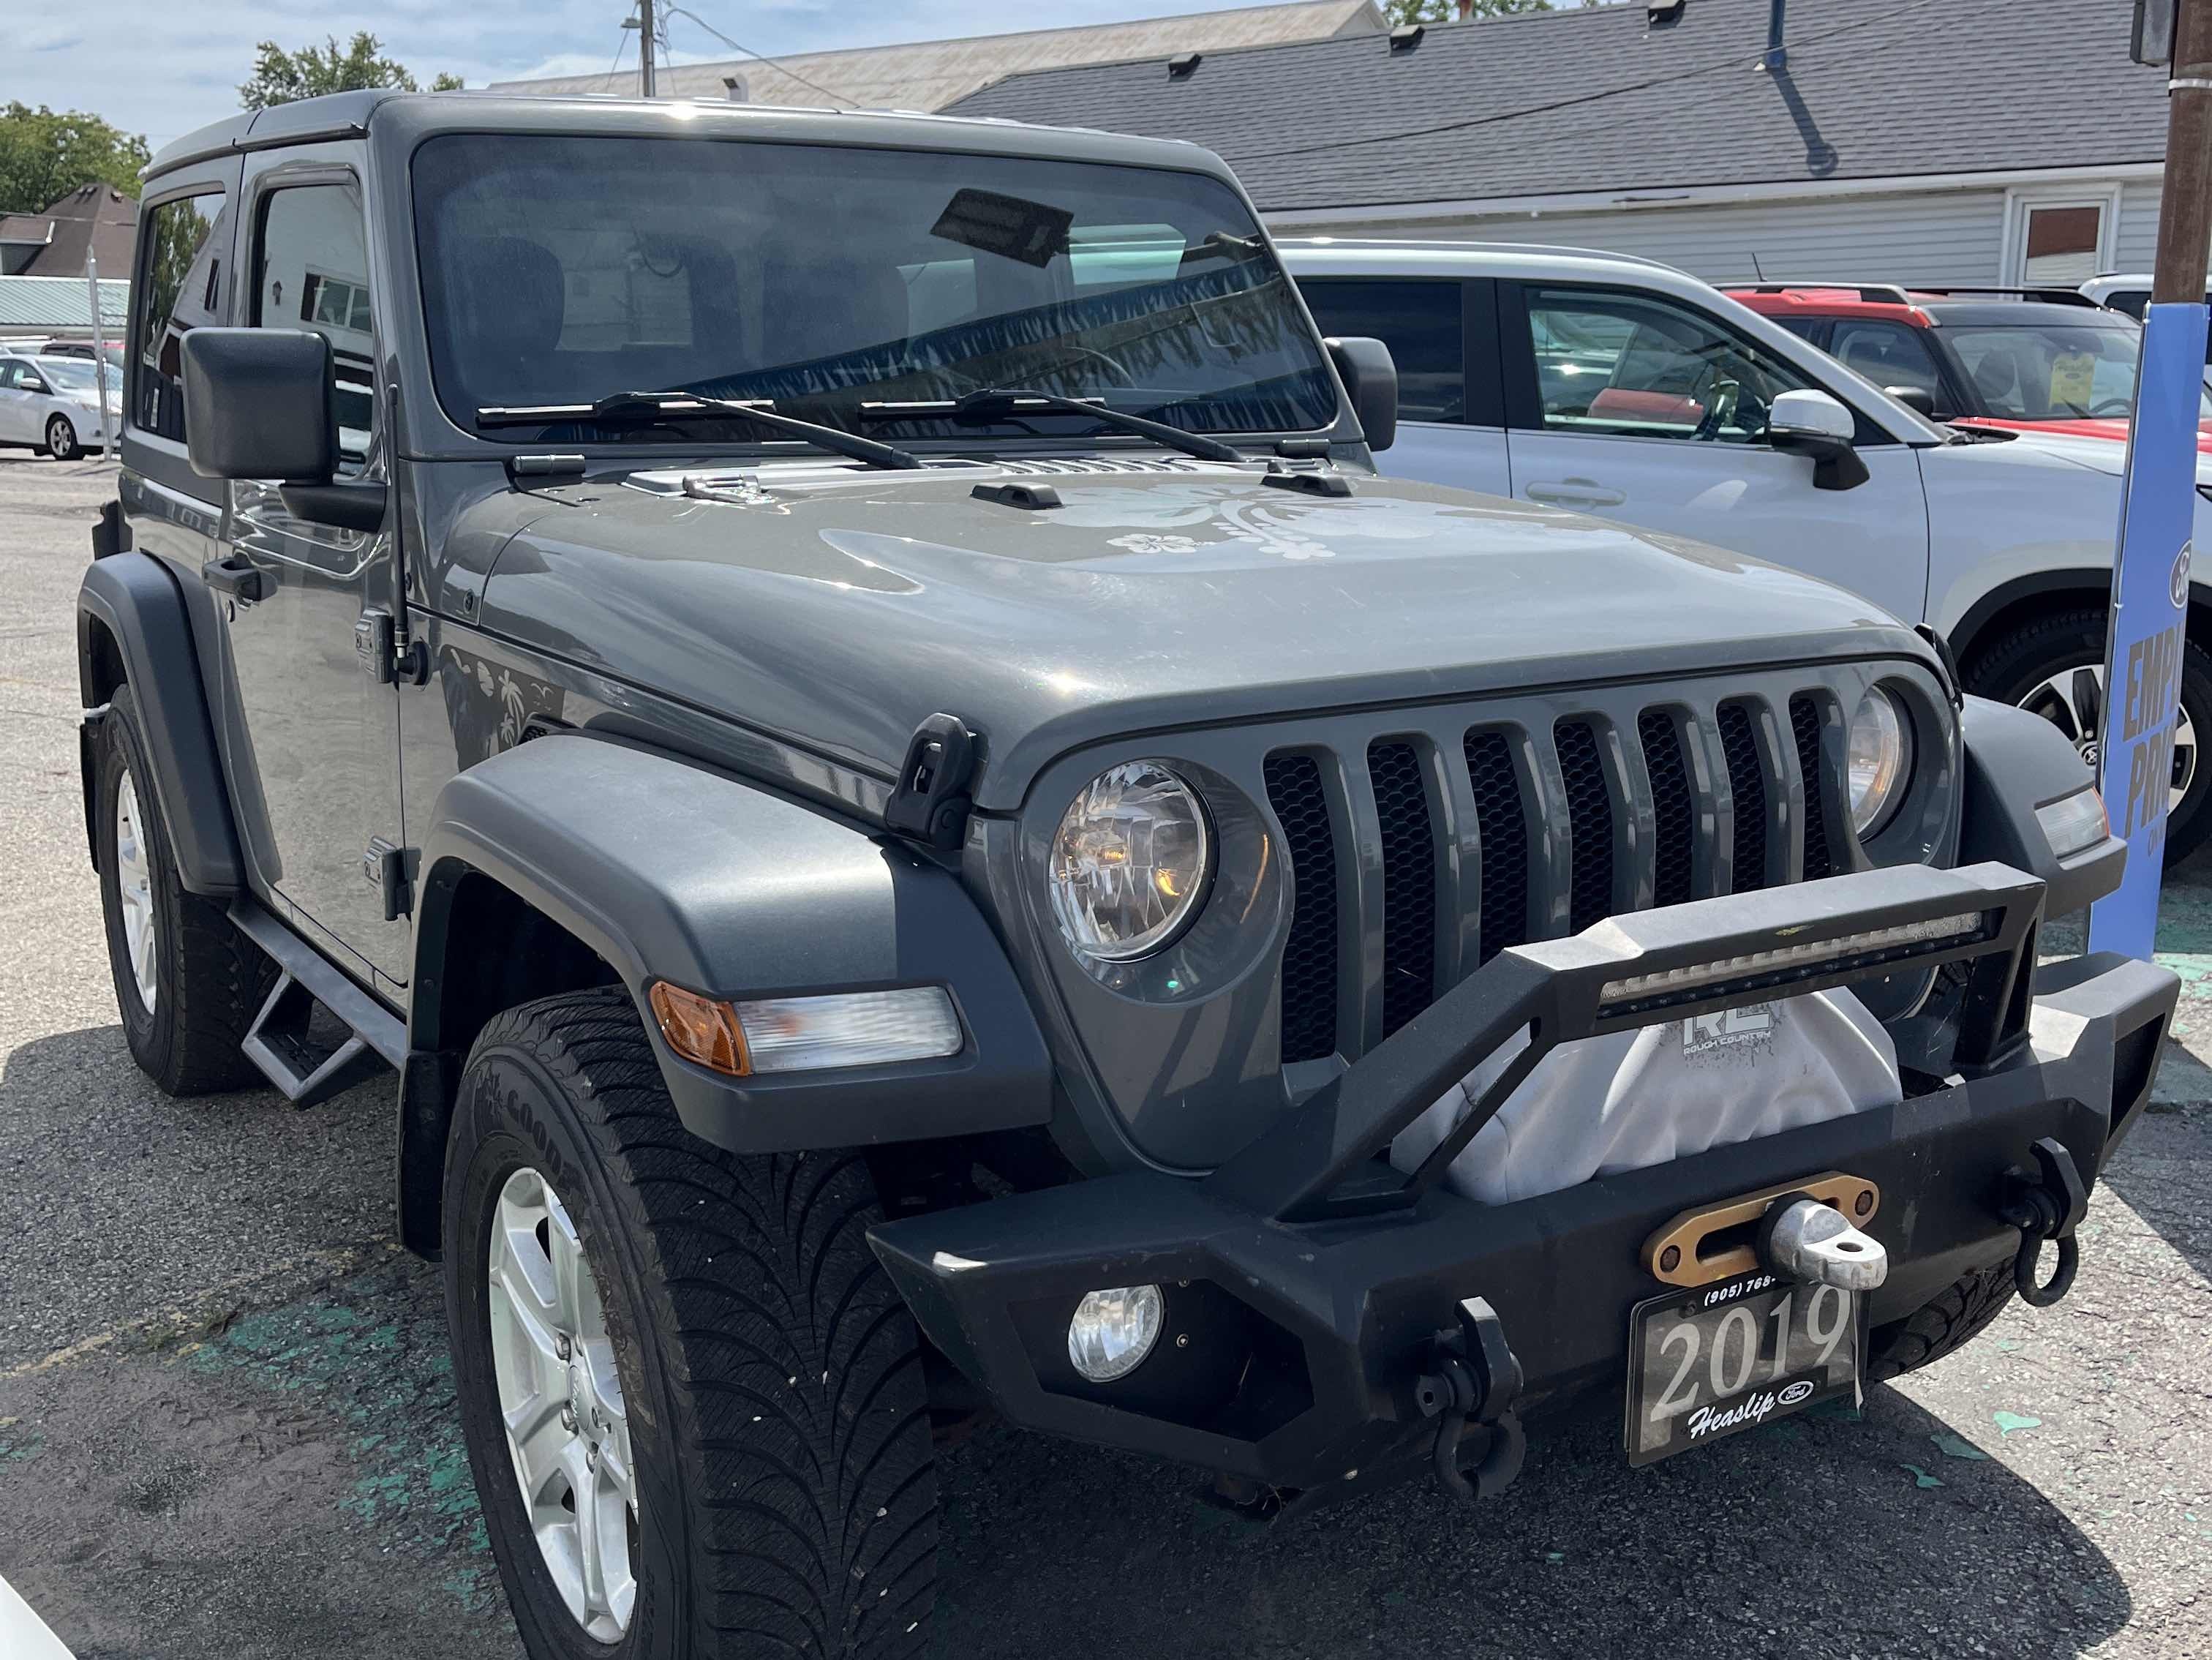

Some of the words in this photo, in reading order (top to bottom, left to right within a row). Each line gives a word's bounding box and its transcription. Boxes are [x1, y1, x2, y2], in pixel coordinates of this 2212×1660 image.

[2123, 622, 2184, 742] EMPL
[1684, 1039, 1718, 1056] ROUGH
[1720, 1030, 1771, 1045] COUNTRY
[1704, 1282, 1742, 1307] (905)
[1746, 1275, 1776, 1293] 768-
[1650, 1282, 1851, 1422] 2019
[1688, 1392, 1776, 1440] Heaslip
